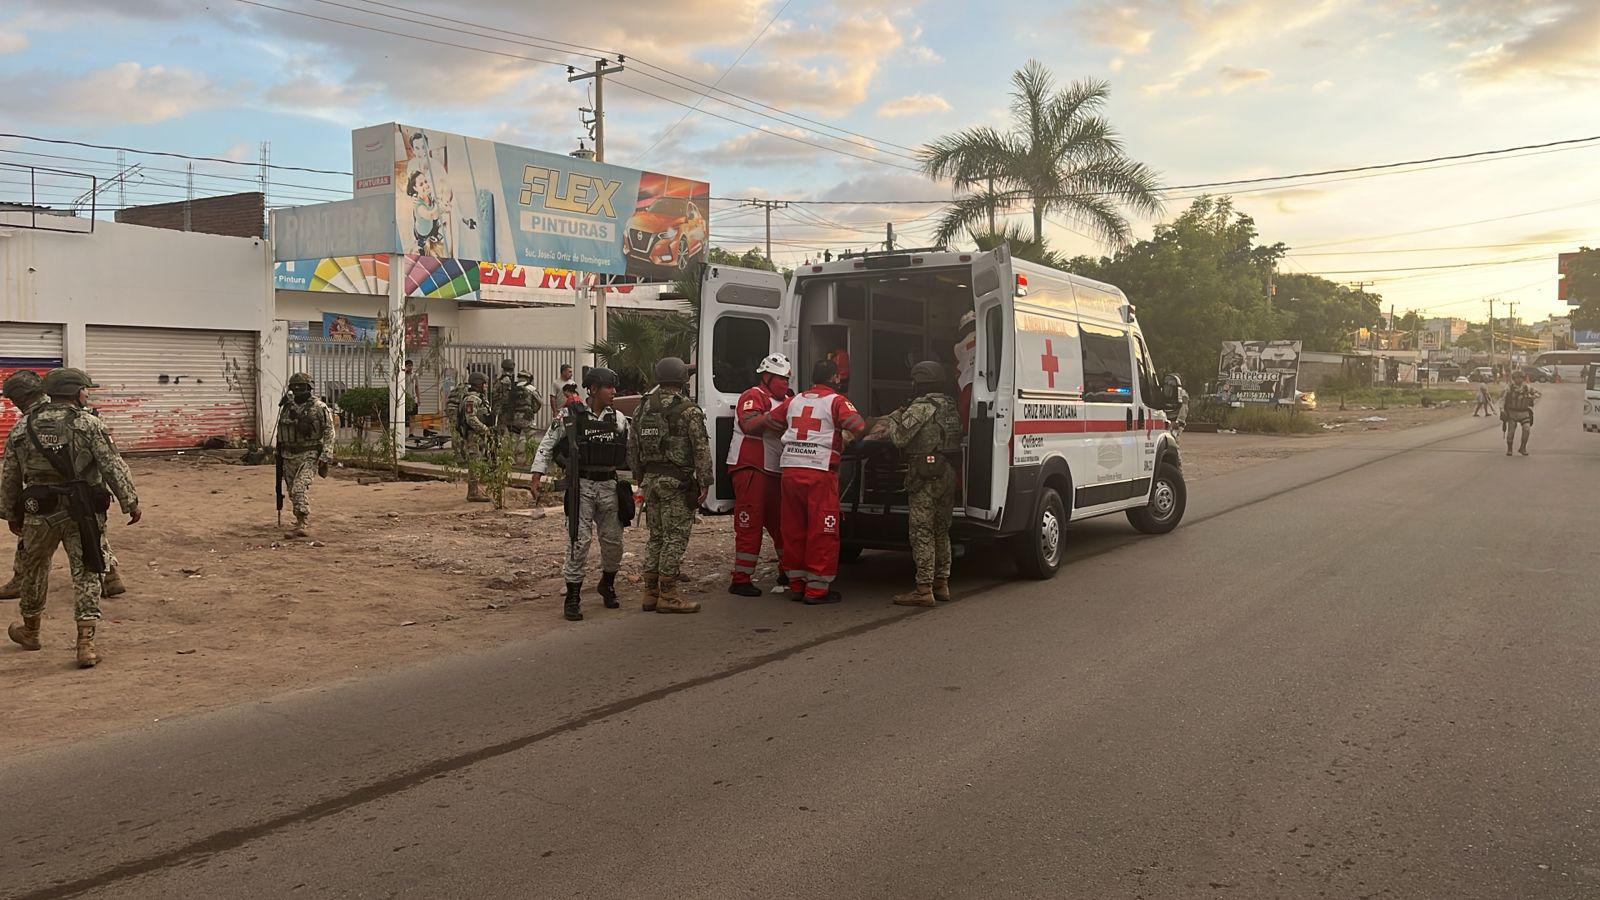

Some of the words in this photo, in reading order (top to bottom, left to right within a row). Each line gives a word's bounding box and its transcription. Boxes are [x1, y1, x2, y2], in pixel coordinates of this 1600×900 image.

[519, 164, 622, 218] FLEX
[531, 215, 608, 239] PINTURAS
[278, 275, 306, 284] Pintura
[1024, 403, 1038, 419] CRUZ
[1039, 403, 1052, 419] ROJA
[1052, 404, 1078, 419] MEXICANA
[787, 447, 817, 455] MEXICANA
